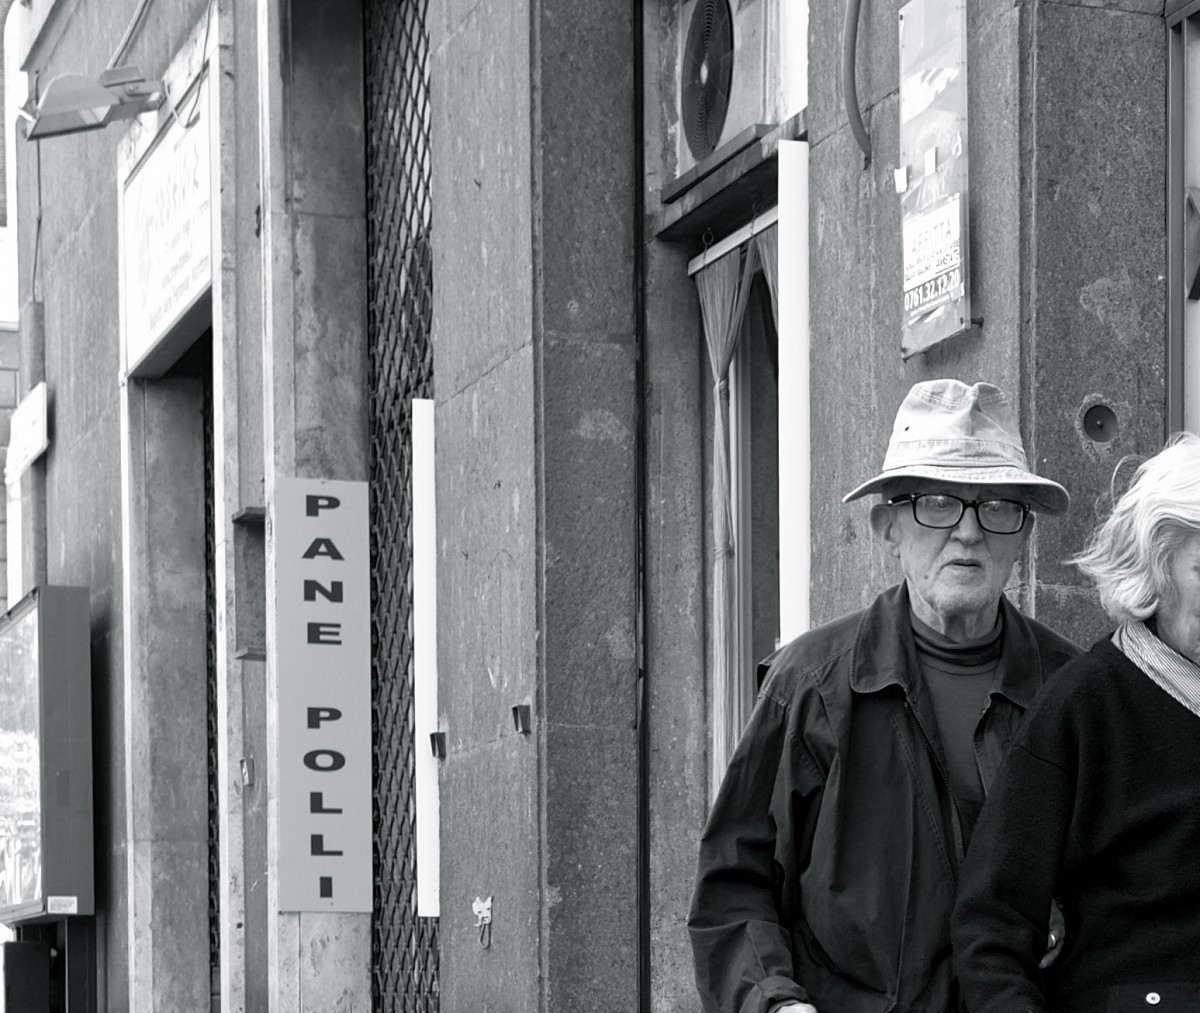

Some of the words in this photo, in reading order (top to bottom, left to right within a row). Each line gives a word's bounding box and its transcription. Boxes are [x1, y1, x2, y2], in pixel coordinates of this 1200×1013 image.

[911, 217, 952, 256] AFFITTA
[301, 494, 345, 645] PANE
[303, 707, 346, 898] POLLI
